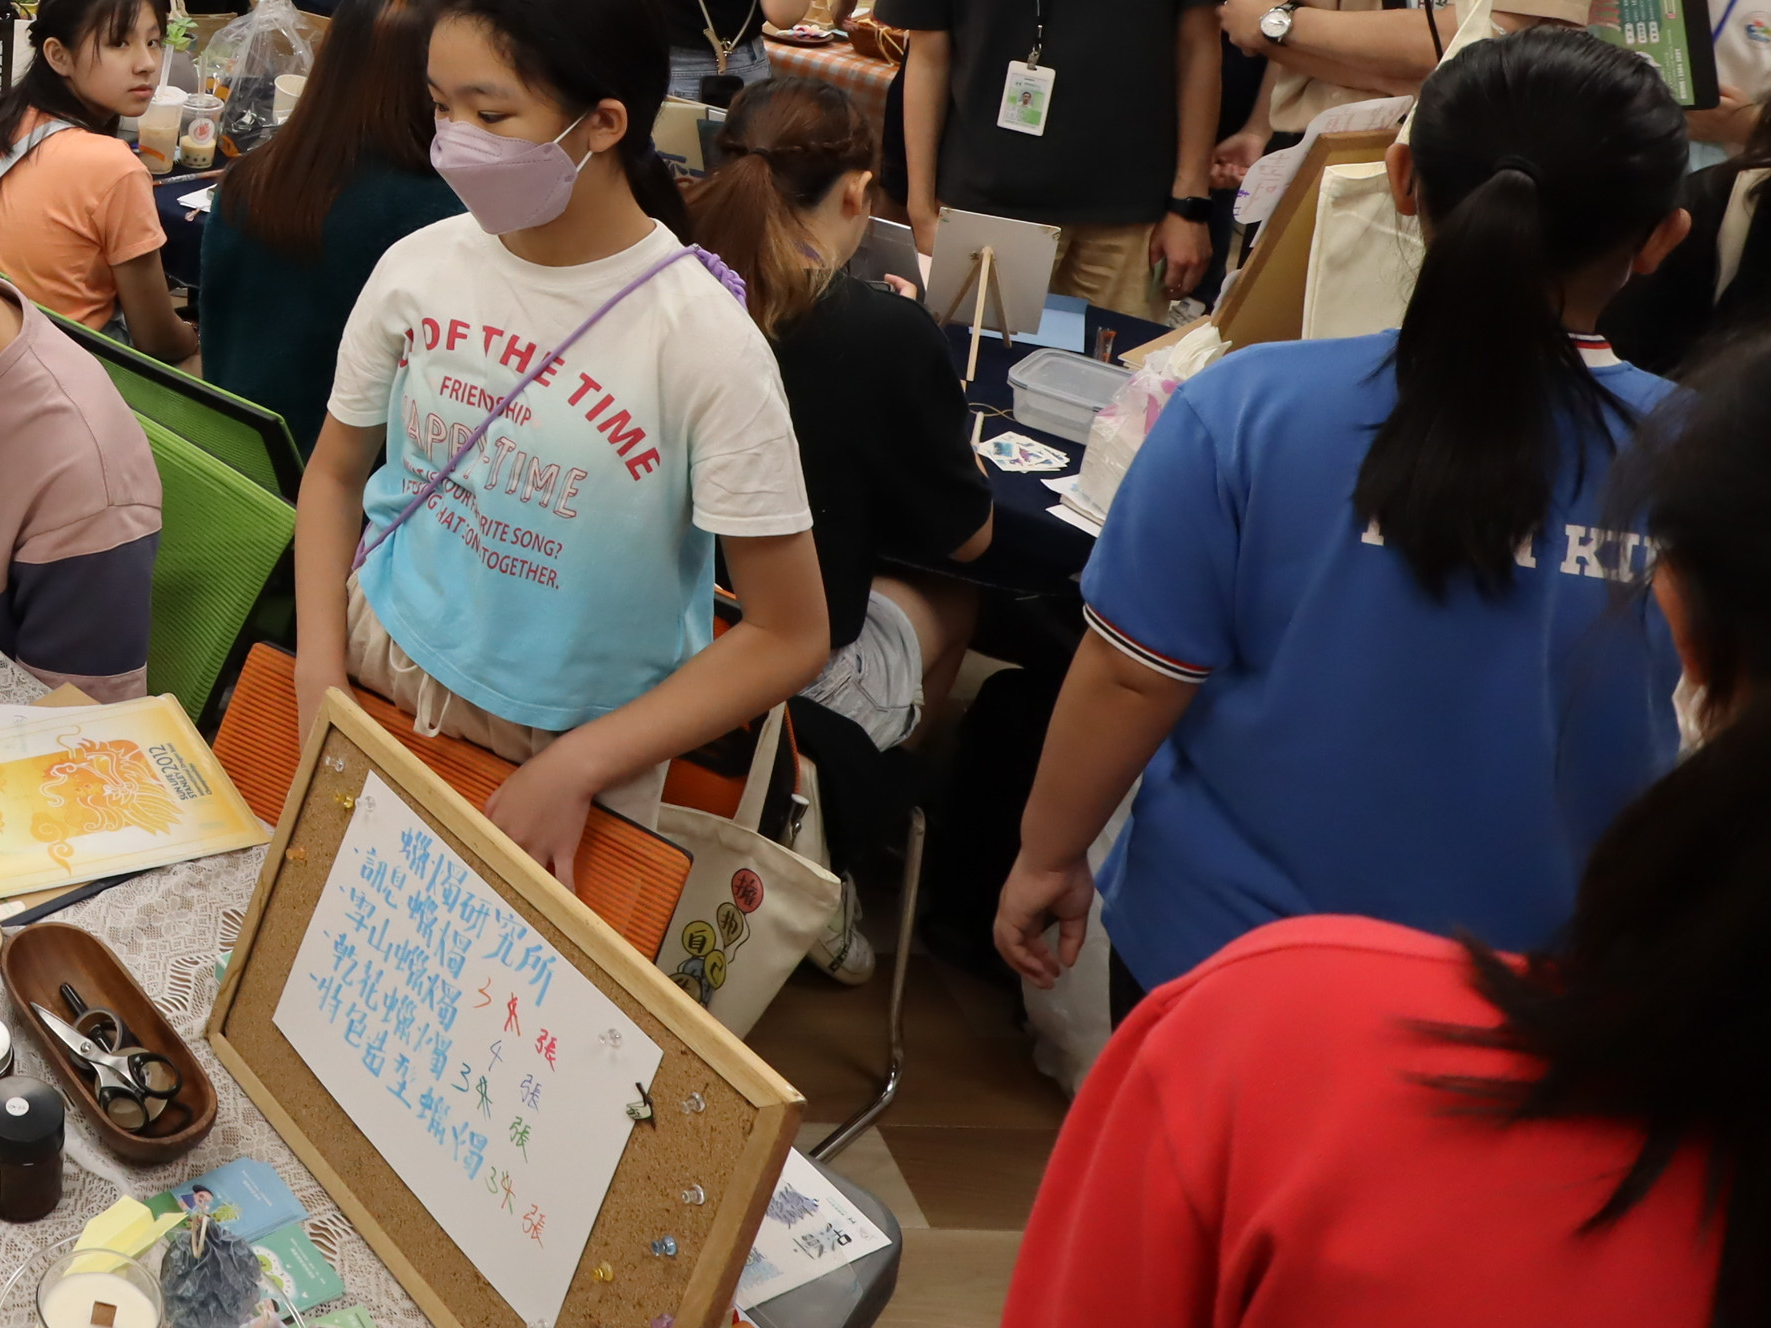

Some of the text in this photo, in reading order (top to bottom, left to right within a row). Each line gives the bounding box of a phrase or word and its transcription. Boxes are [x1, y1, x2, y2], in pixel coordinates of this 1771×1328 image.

[421, 317, 470, 351] OF
[482, 325, 565, 387] THE
[567, 372, 660, 482] TIME
[510, 527, 563, 560] SONG?
[480, 546, 560, 590] TOGETHER.
[149, 744, 197, 797] STANLEY 2012
[166, 773, 187, 800] SUN LIFE
[688, 929, 707, 953] 自
